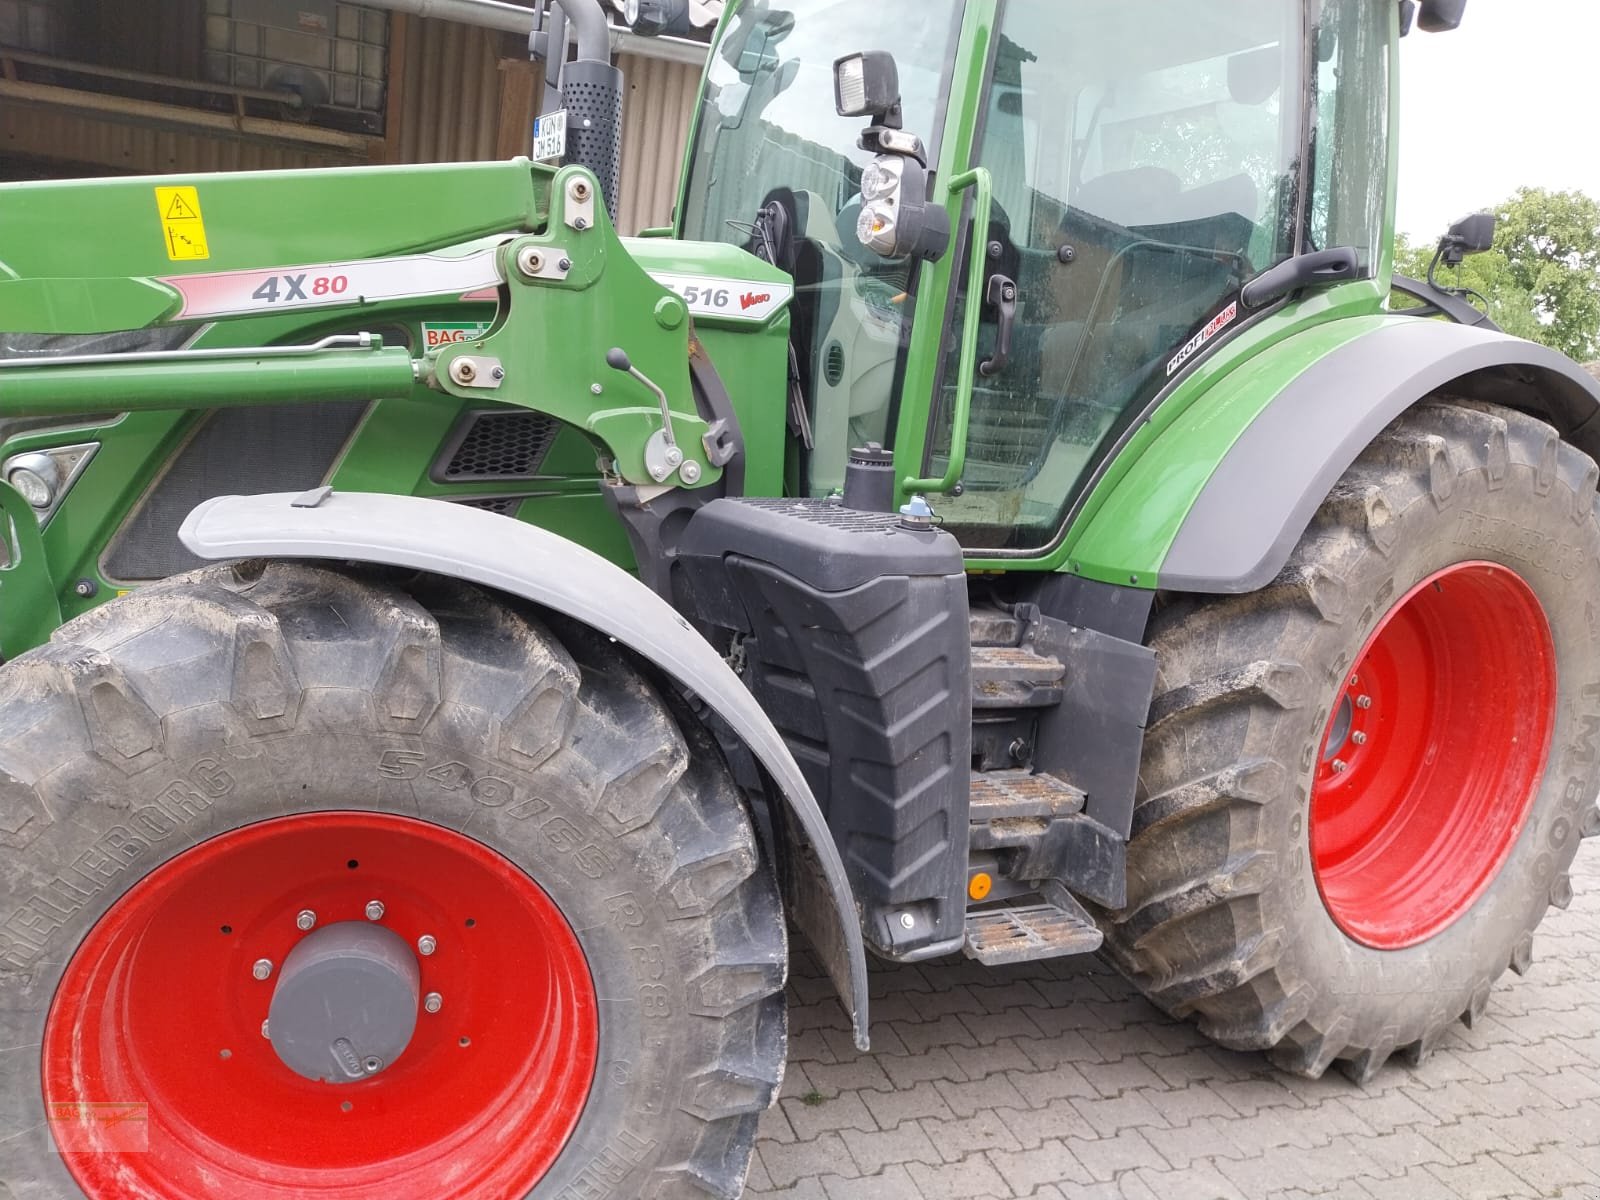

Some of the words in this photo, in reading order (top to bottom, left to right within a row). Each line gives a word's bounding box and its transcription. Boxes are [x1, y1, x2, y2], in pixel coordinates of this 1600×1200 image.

[547, 135, 561, 156] 516
[683, 286, 729, 308] 516
[0, 758, 235, 985] RELLEBORG
